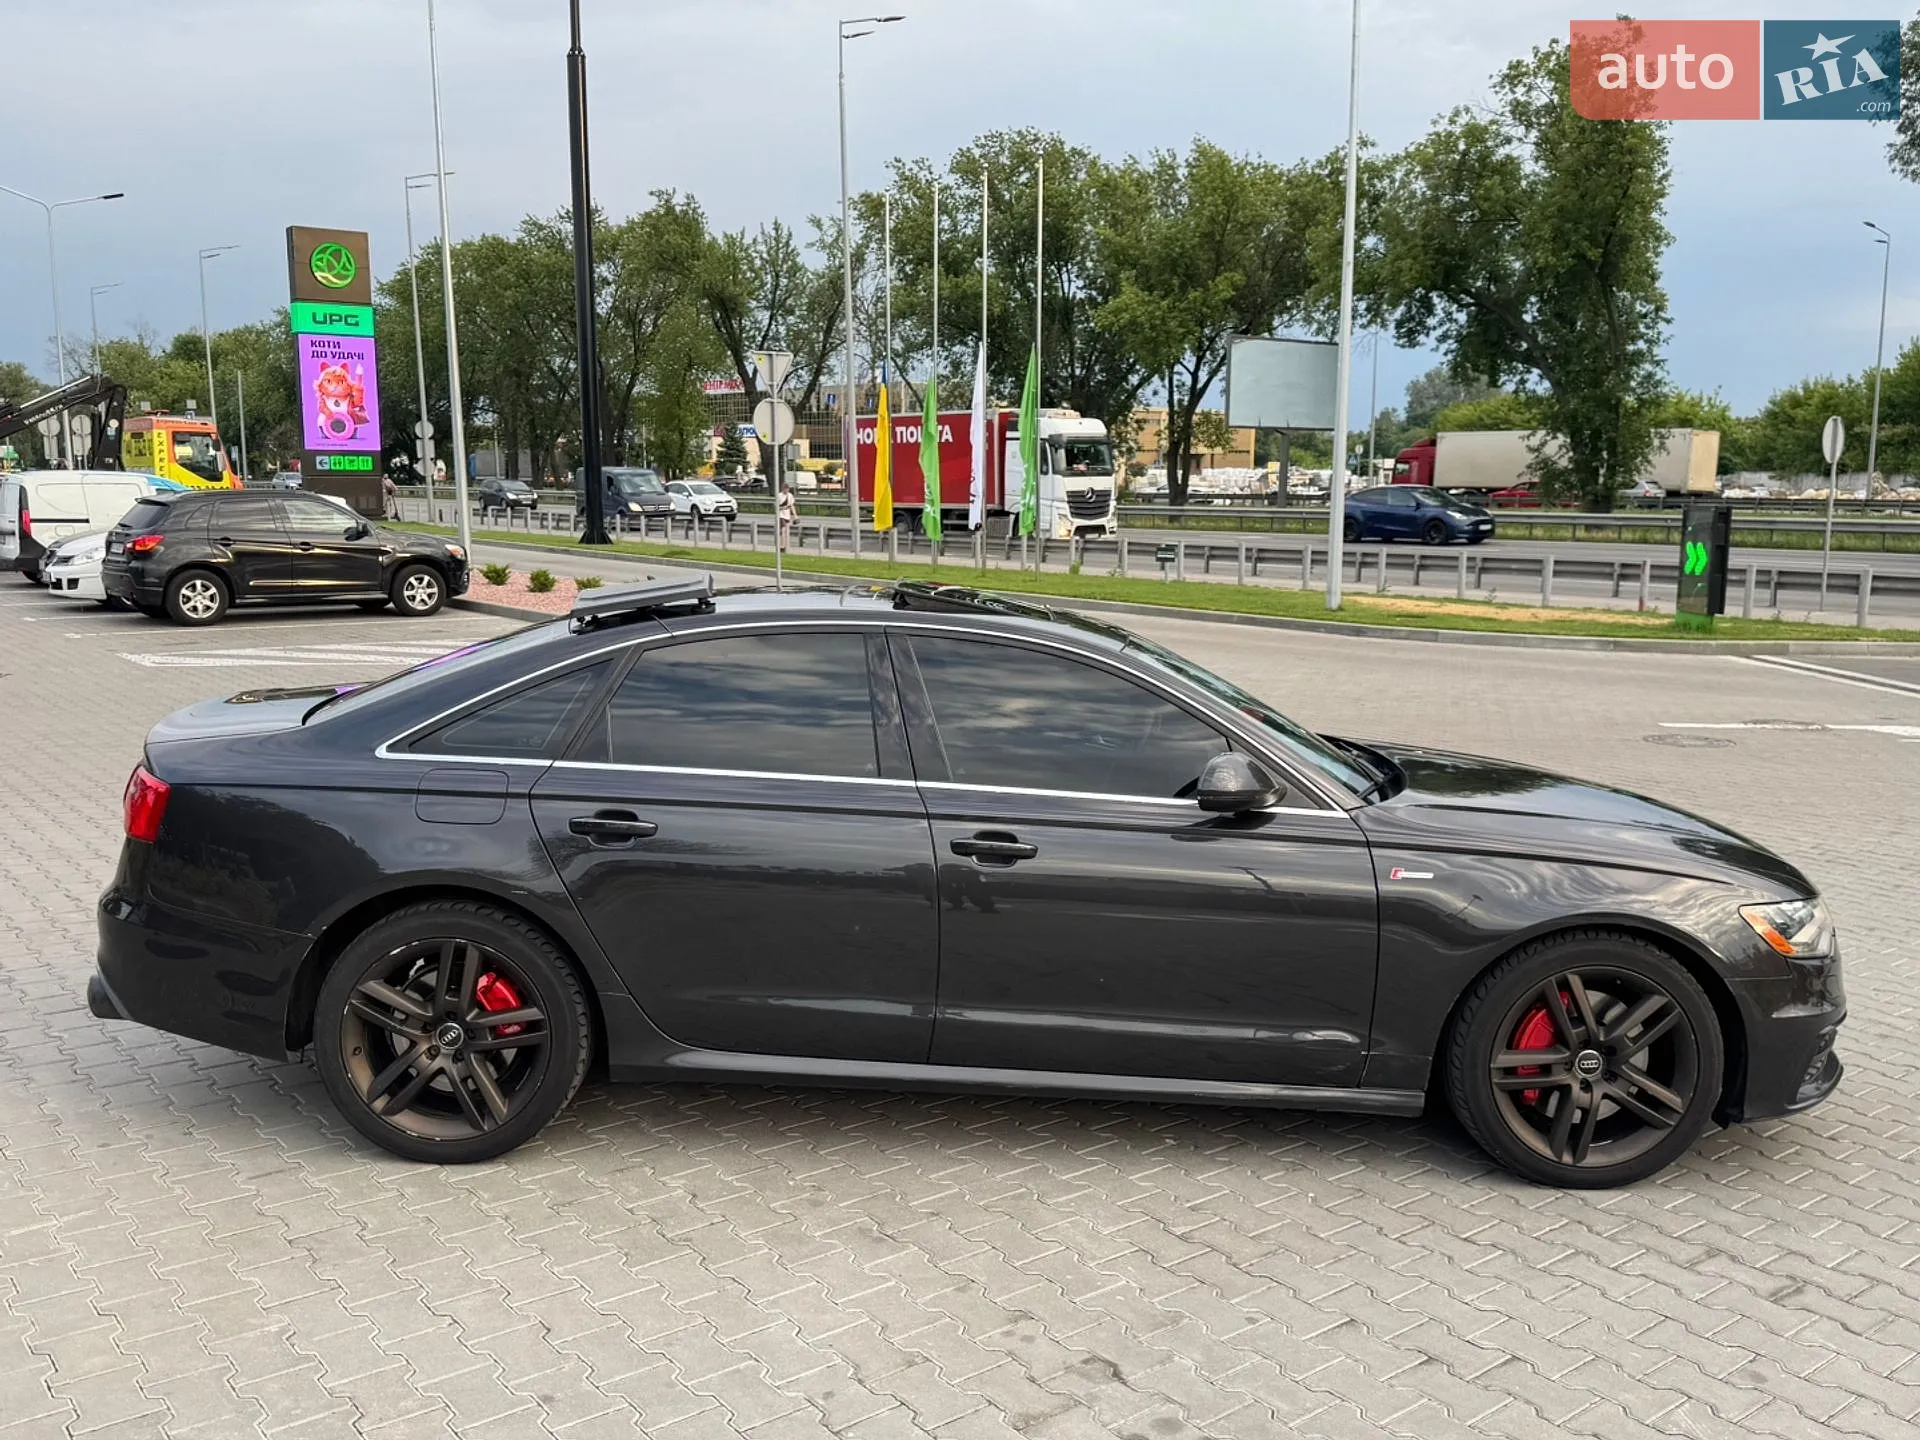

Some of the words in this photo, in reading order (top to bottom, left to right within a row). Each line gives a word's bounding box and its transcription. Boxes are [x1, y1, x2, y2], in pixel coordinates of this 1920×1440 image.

[311, 311, 360, 327] UPG
[310, 339, 342, 349] КОТИ
[310, 350, 328, 359] ДО
[330, 351, 365, 360] УДАЧІ
